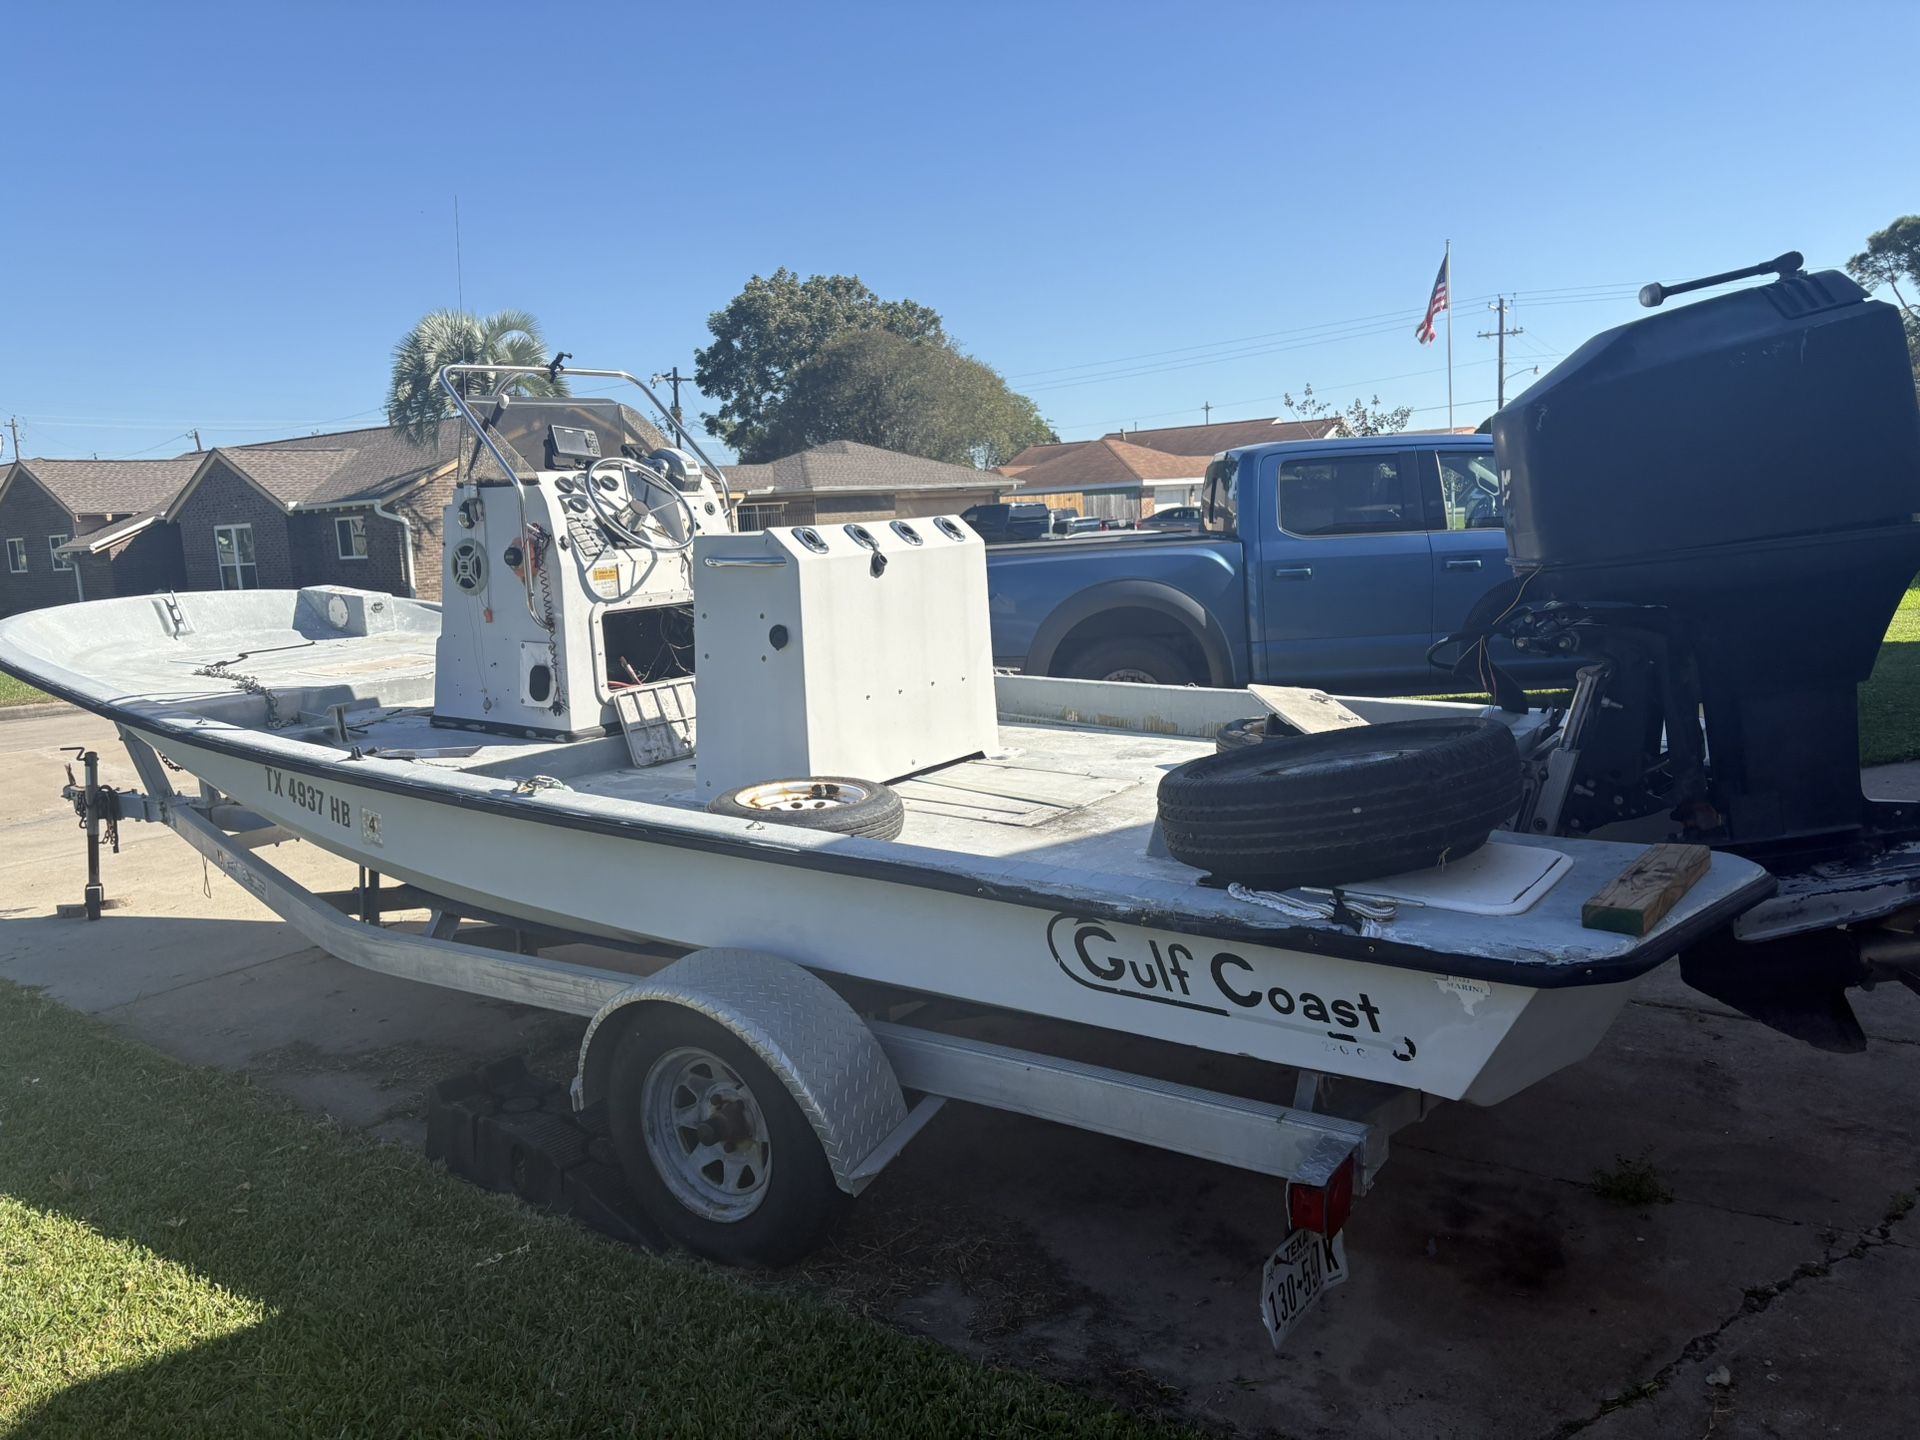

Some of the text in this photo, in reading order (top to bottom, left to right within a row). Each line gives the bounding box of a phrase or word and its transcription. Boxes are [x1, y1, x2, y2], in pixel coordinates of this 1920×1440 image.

[265, 766, 351, 828] TX 4937 HB
[368, 816, 376, 832] 4
[1074, 926, 1381, 1033] Gulf Coast
[1285, 1230, 1310, 1259] TEXA
